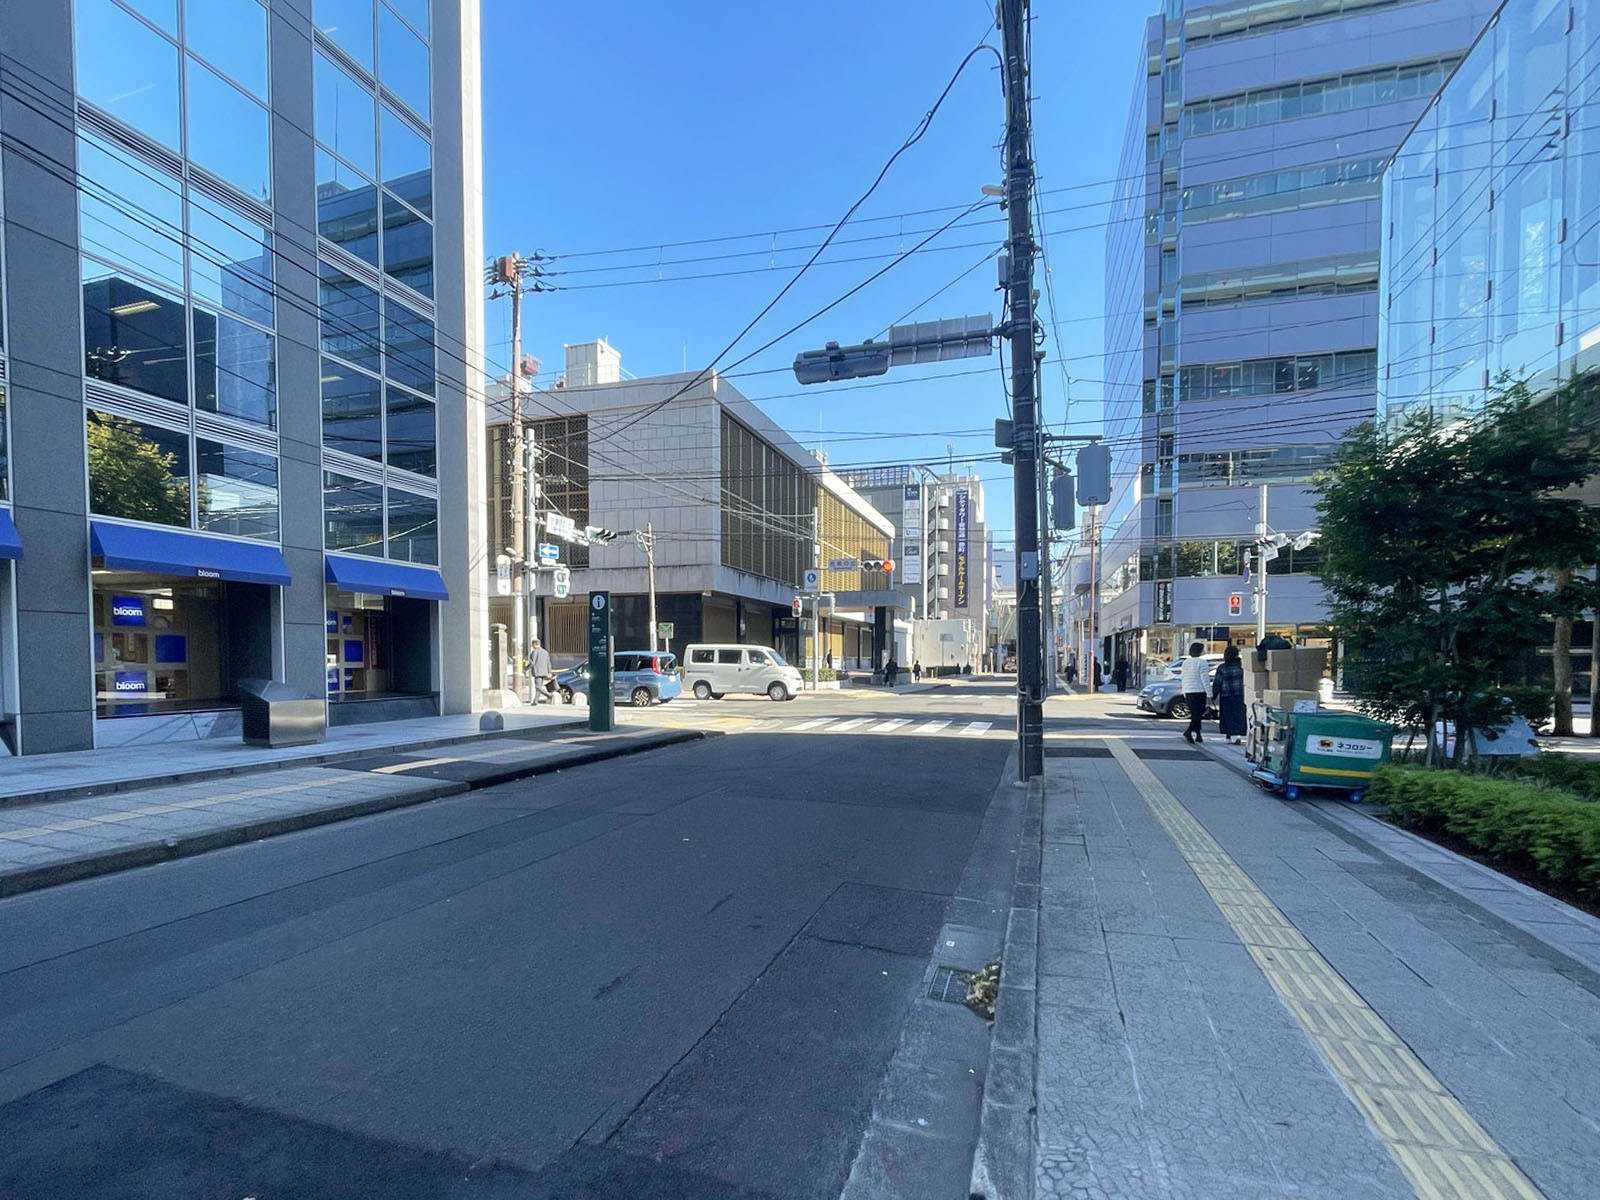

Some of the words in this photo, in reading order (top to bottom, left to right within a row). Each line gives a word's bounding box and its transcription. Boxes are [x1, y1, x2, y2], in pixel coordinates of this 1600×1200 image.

[198, 569, 220, 578] bloom
[113, 606, 143, 616] bloom
[116, 681, 145, 690] bloom
[1337, 741, 1373, 751] ネコロジー
